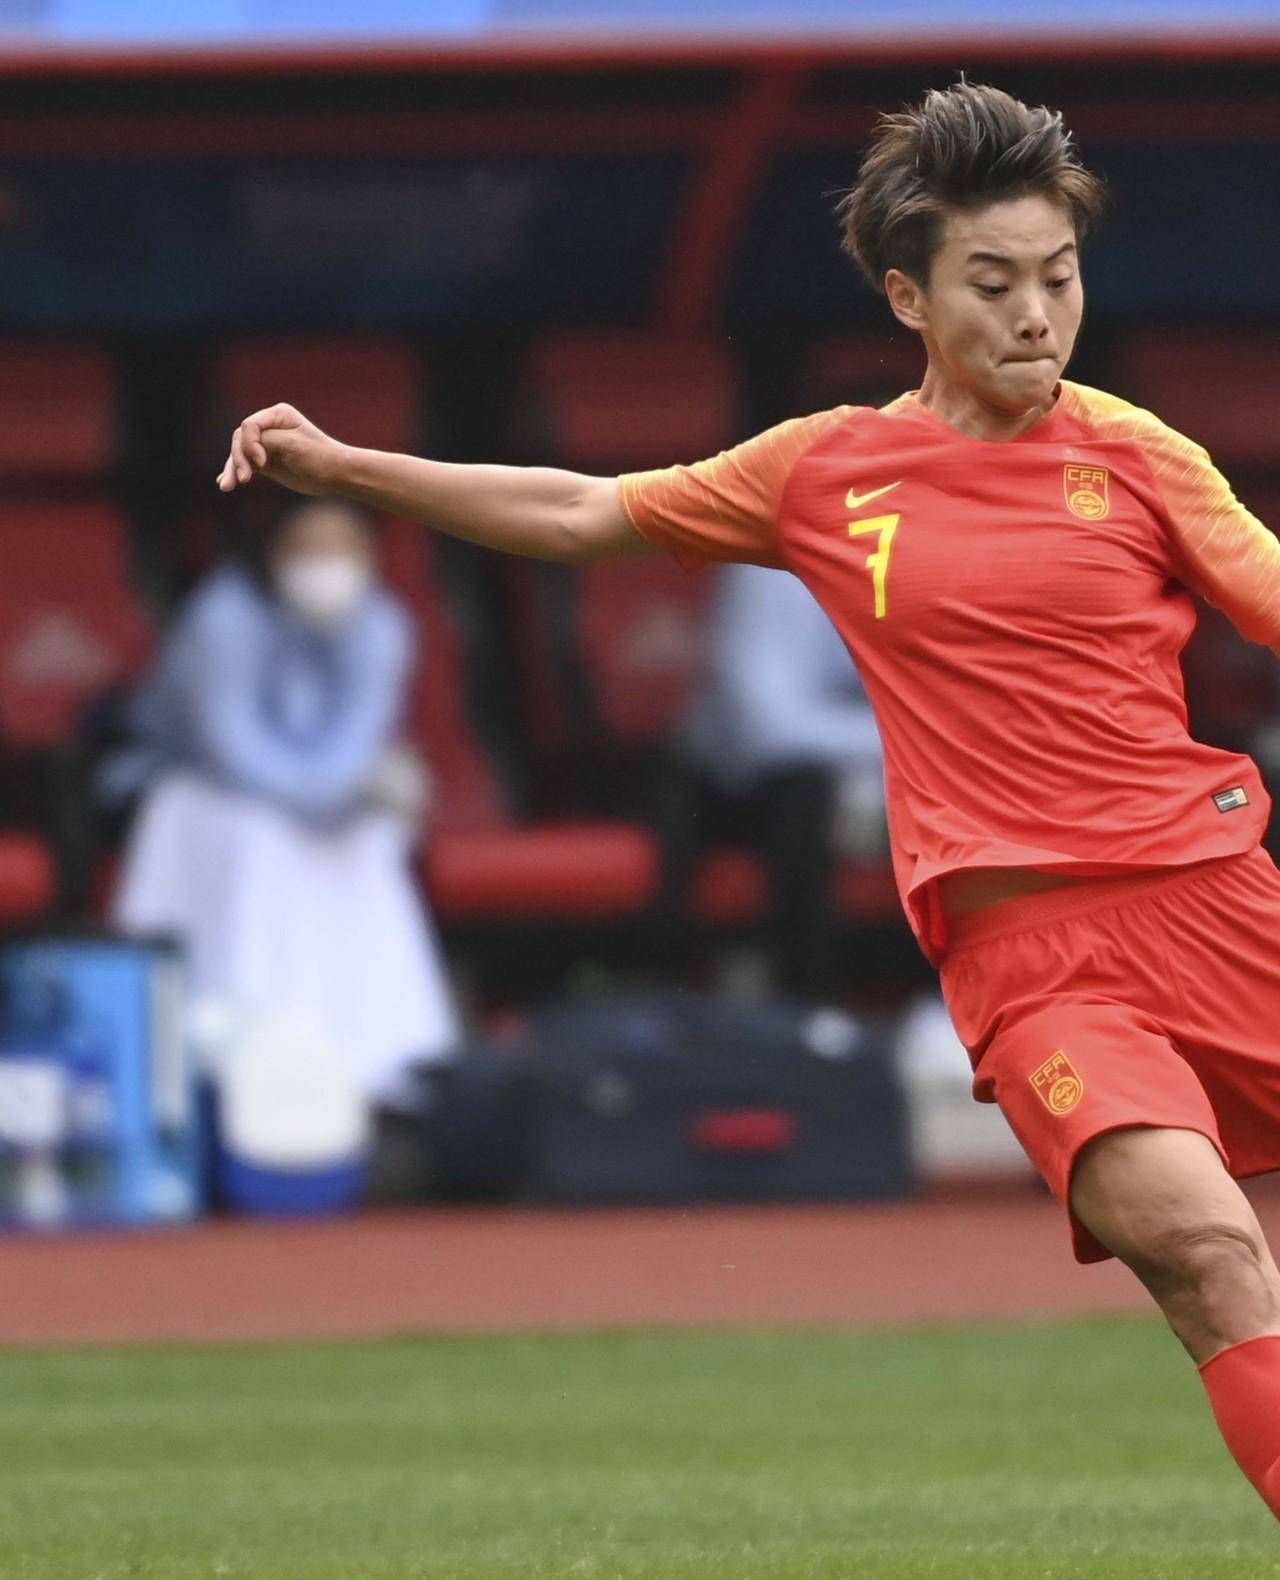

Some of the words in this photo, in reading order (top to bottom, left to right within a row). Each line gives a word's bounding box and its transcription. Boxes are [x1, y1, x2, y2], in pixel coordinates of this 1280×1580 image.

[1067, 468, 1104, 484] CFA
[848, 513, 900, 619] 7
[1033, 1055, 1065, 1087] CFA
